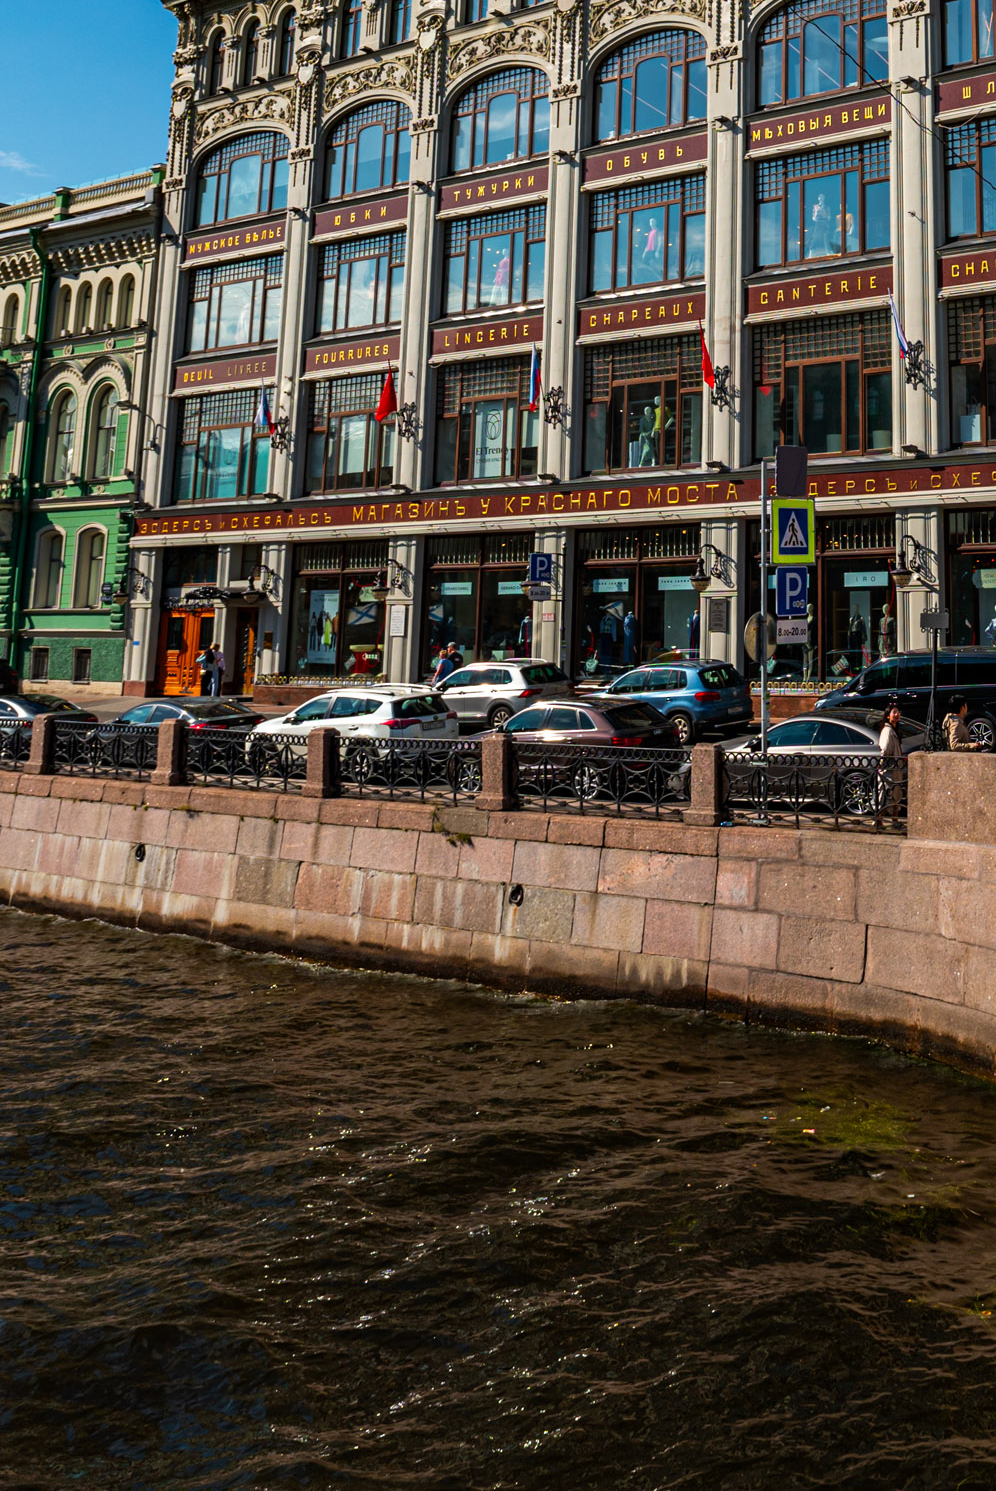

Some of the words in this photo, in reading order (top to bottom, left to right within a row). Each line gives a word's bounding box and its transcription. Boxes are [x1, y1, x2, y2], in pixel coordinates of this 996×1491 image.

[840, 103, 887, 124] ВЕЩИ
[606, 145, 683, 171] ОБУВЬ
[453, 175, 535, 202] ТУЖУРКИ
[334, 206, 387, 226] ЮБКИ
[189, 235, 240, 255] МУЖСКОЕ
[759, 275, 878, 306] GANTERIE
[589, 301, 693, 327] CHAPEAUX
[444, 324, 530, 347] LINGERIE
[315, 344, 389, 365] FOURRURES
[183, 366, 214, 383] DEUIL
[227, 361, 267, 377] LIVREE
[140, 519, 212, 534] ЭСДЕРСЪ
[230, 512, 332, 529] СХЕФАЛЬСЪ
[352, 499, 466, 522] МАГАЗИНЪ
[480, 497, 491, 515] У
[504, 489, 631, 514] КРАСНАГО
[647, 483, 738, 506] МОСТА
[769, 476, 897, 497] ЭДЕРСЪ
[855, 575, 876, 583] IRO
[778, 626, 807, 637] 8.00-20.00
